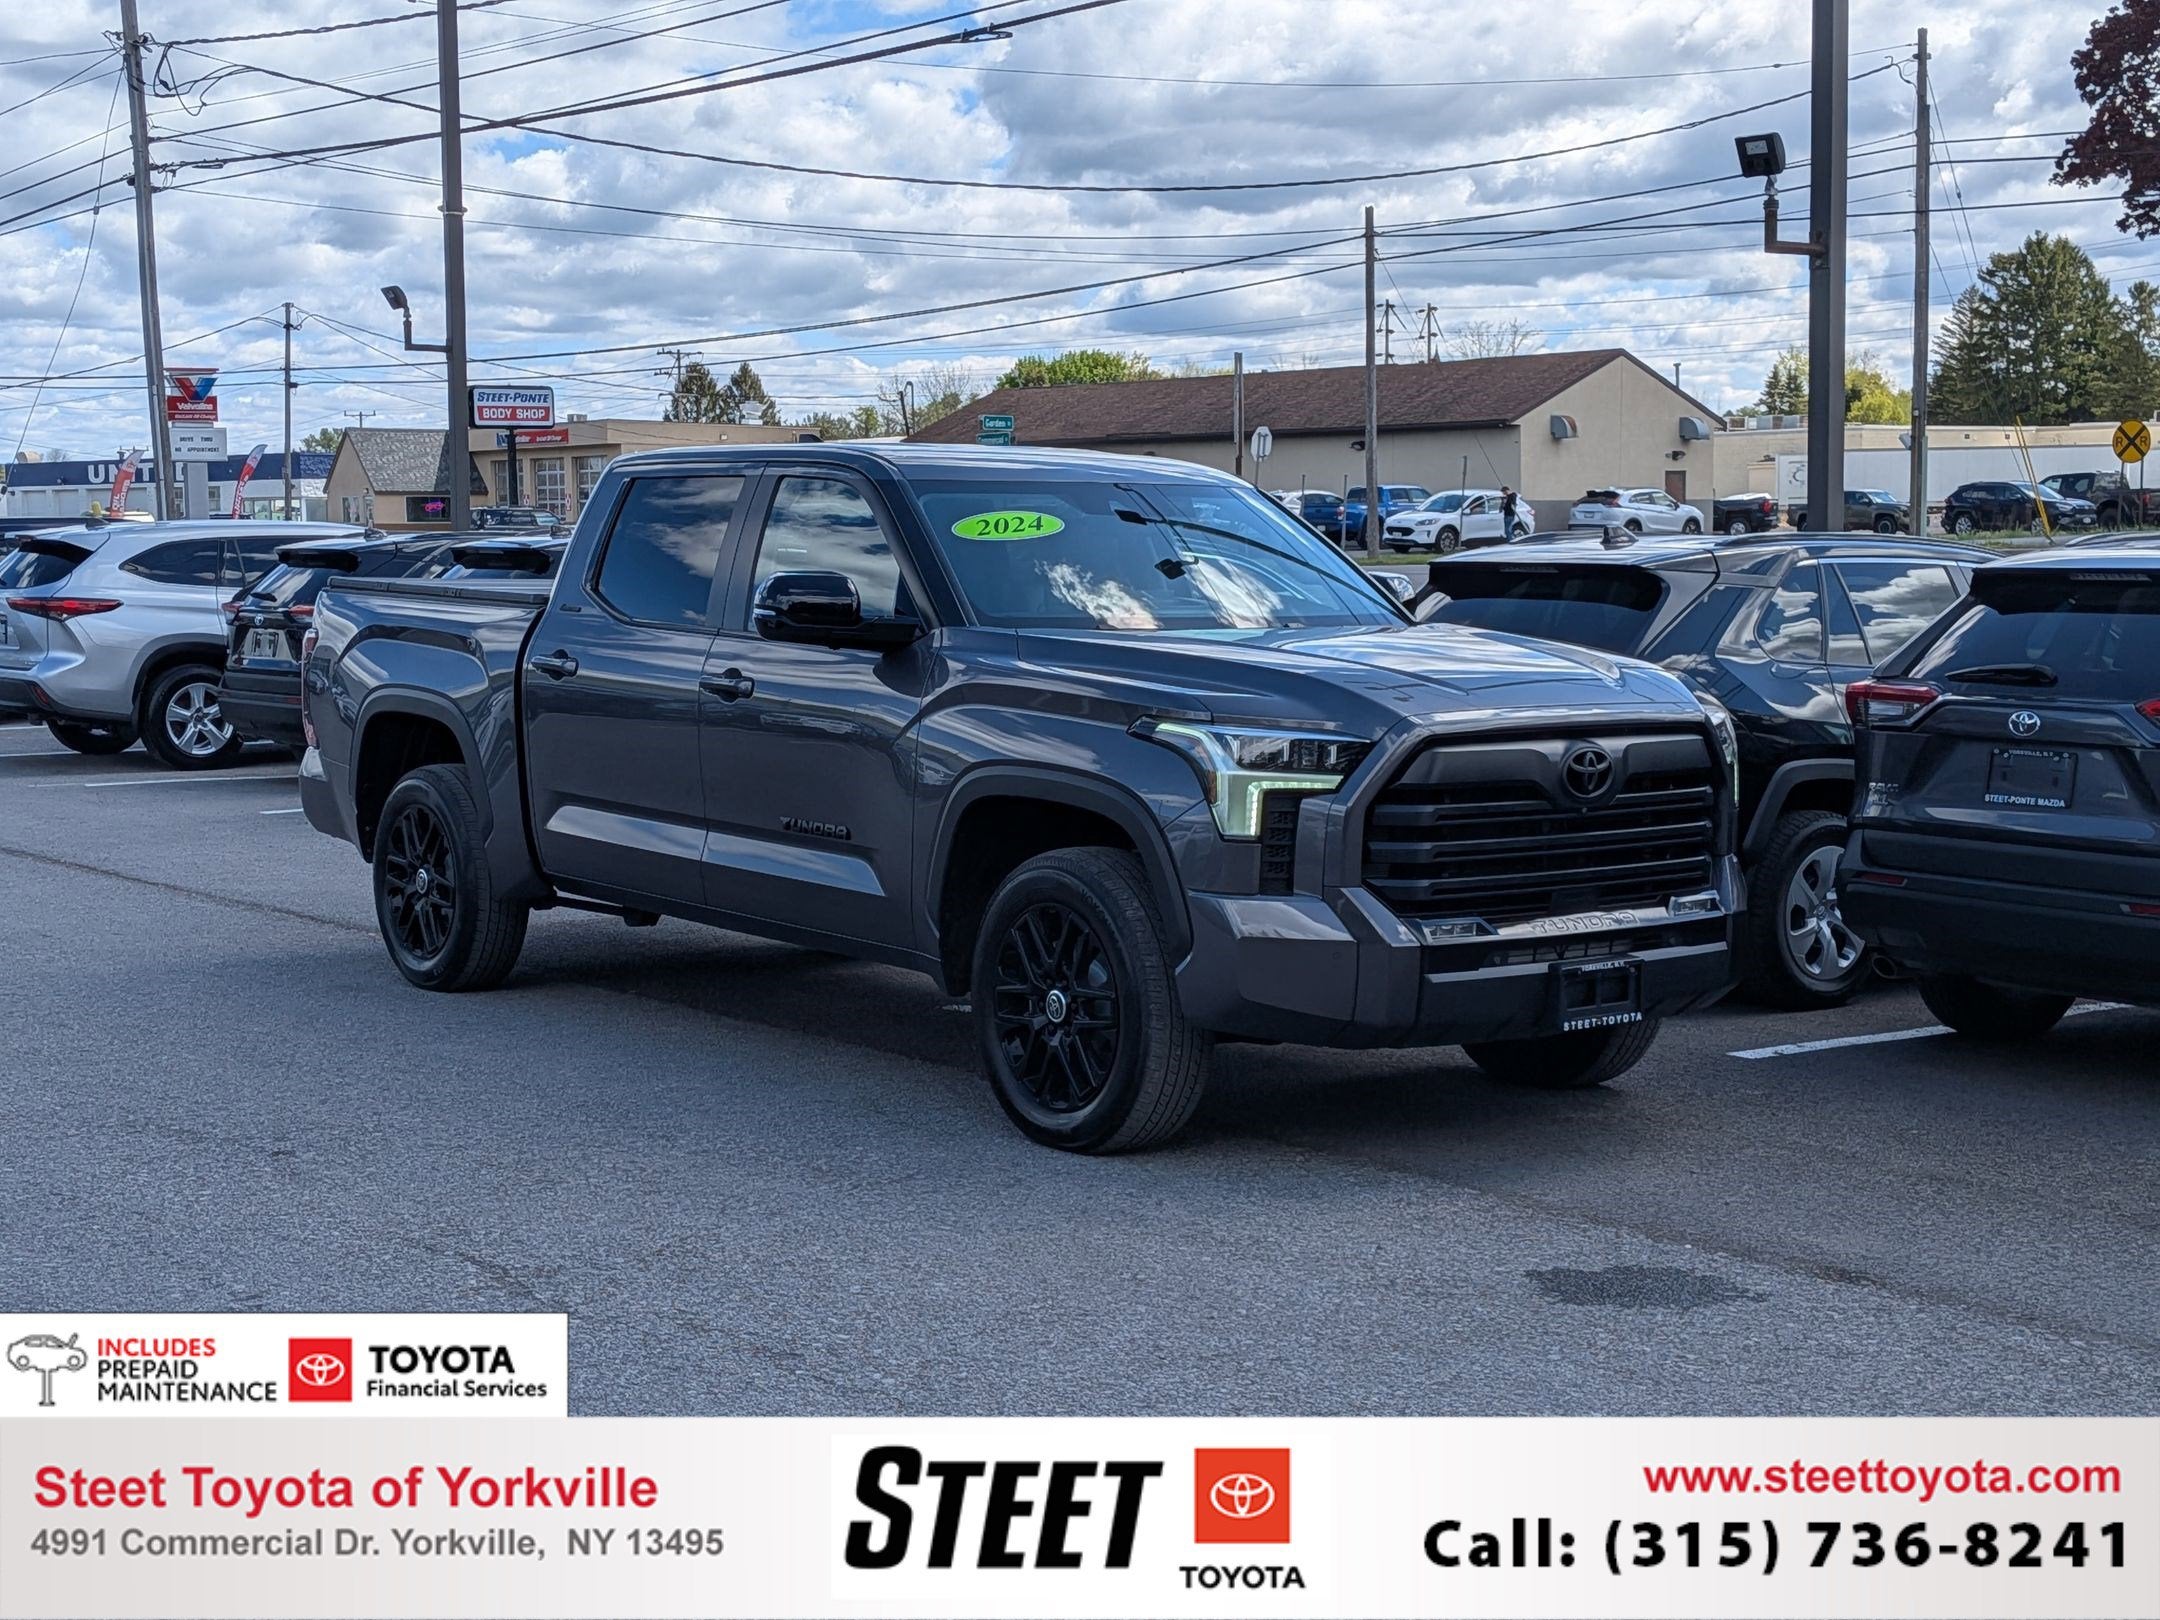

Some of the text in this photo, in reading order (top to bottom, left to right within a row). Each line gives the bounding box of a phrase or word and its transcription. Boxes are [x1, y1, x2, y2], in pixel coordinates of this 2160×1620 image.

[477, 391, 550, 403] STEET-PONTE
[482, 407, 546, 419] BODY SHOP
[2115, 436, 2124, 449] R
[2139, 435, 2148, 447] R
[975, 514, 1044, 537] 2024
[1984, 793, 2066, 808] STEET-PONTE MAZDA
[779, 815, 852, 841] TUNDRA
[1531, 910, 1639, 935] TUNDRA
[1563, 1011, 1643, 1032] STEET-TOYOTA
